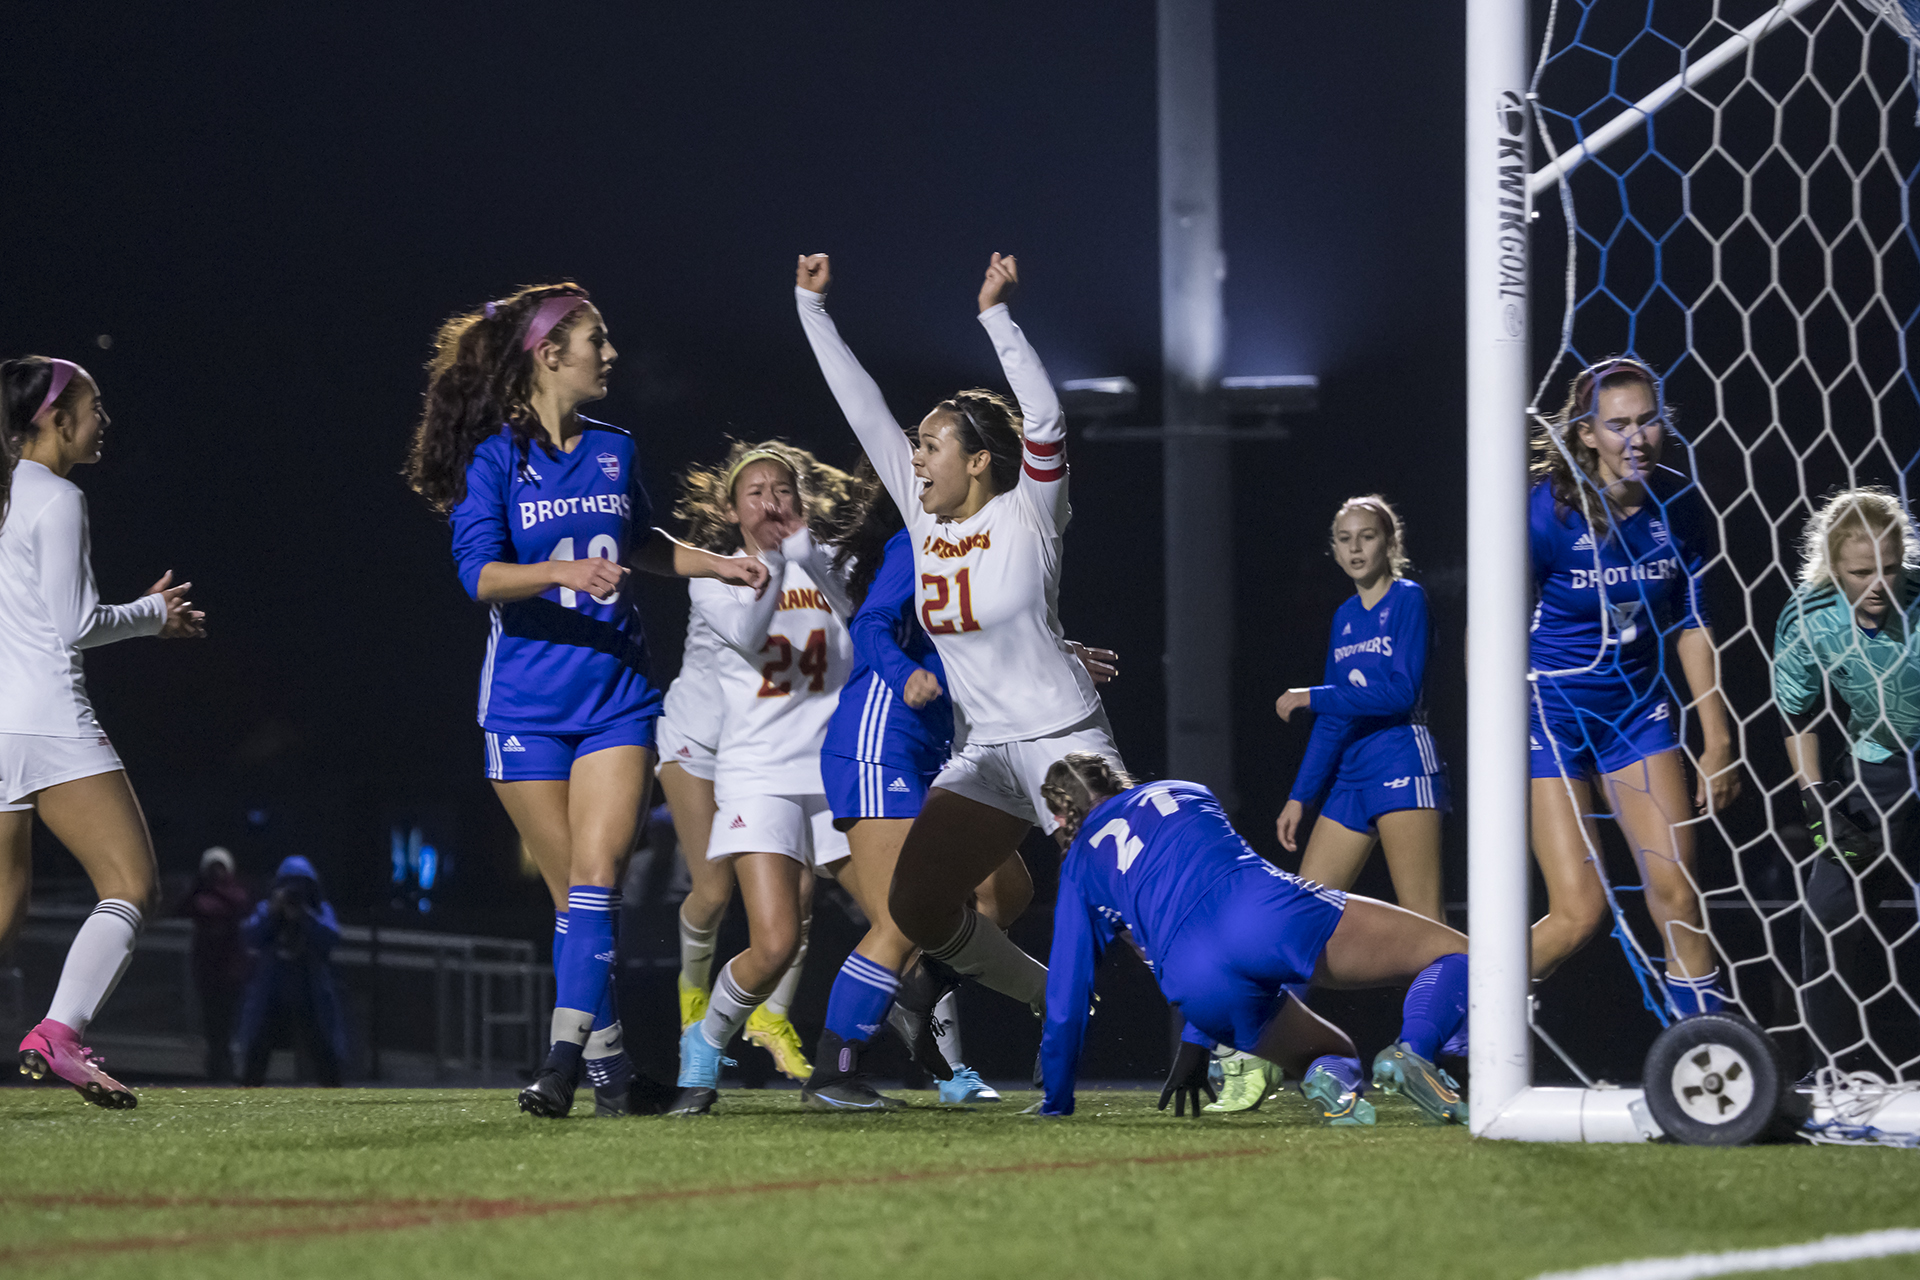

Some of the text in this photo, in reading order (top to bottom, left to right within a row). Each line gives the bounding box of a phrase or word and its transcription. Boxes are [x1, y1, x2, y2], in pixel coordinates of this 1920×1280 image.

[518, 494, 631, 530] BROTHERS
[921, 567, 982, 635] 21
[758, 628, 828, 697] 24
[1334, 635, 1393, 664] BROTHERS
